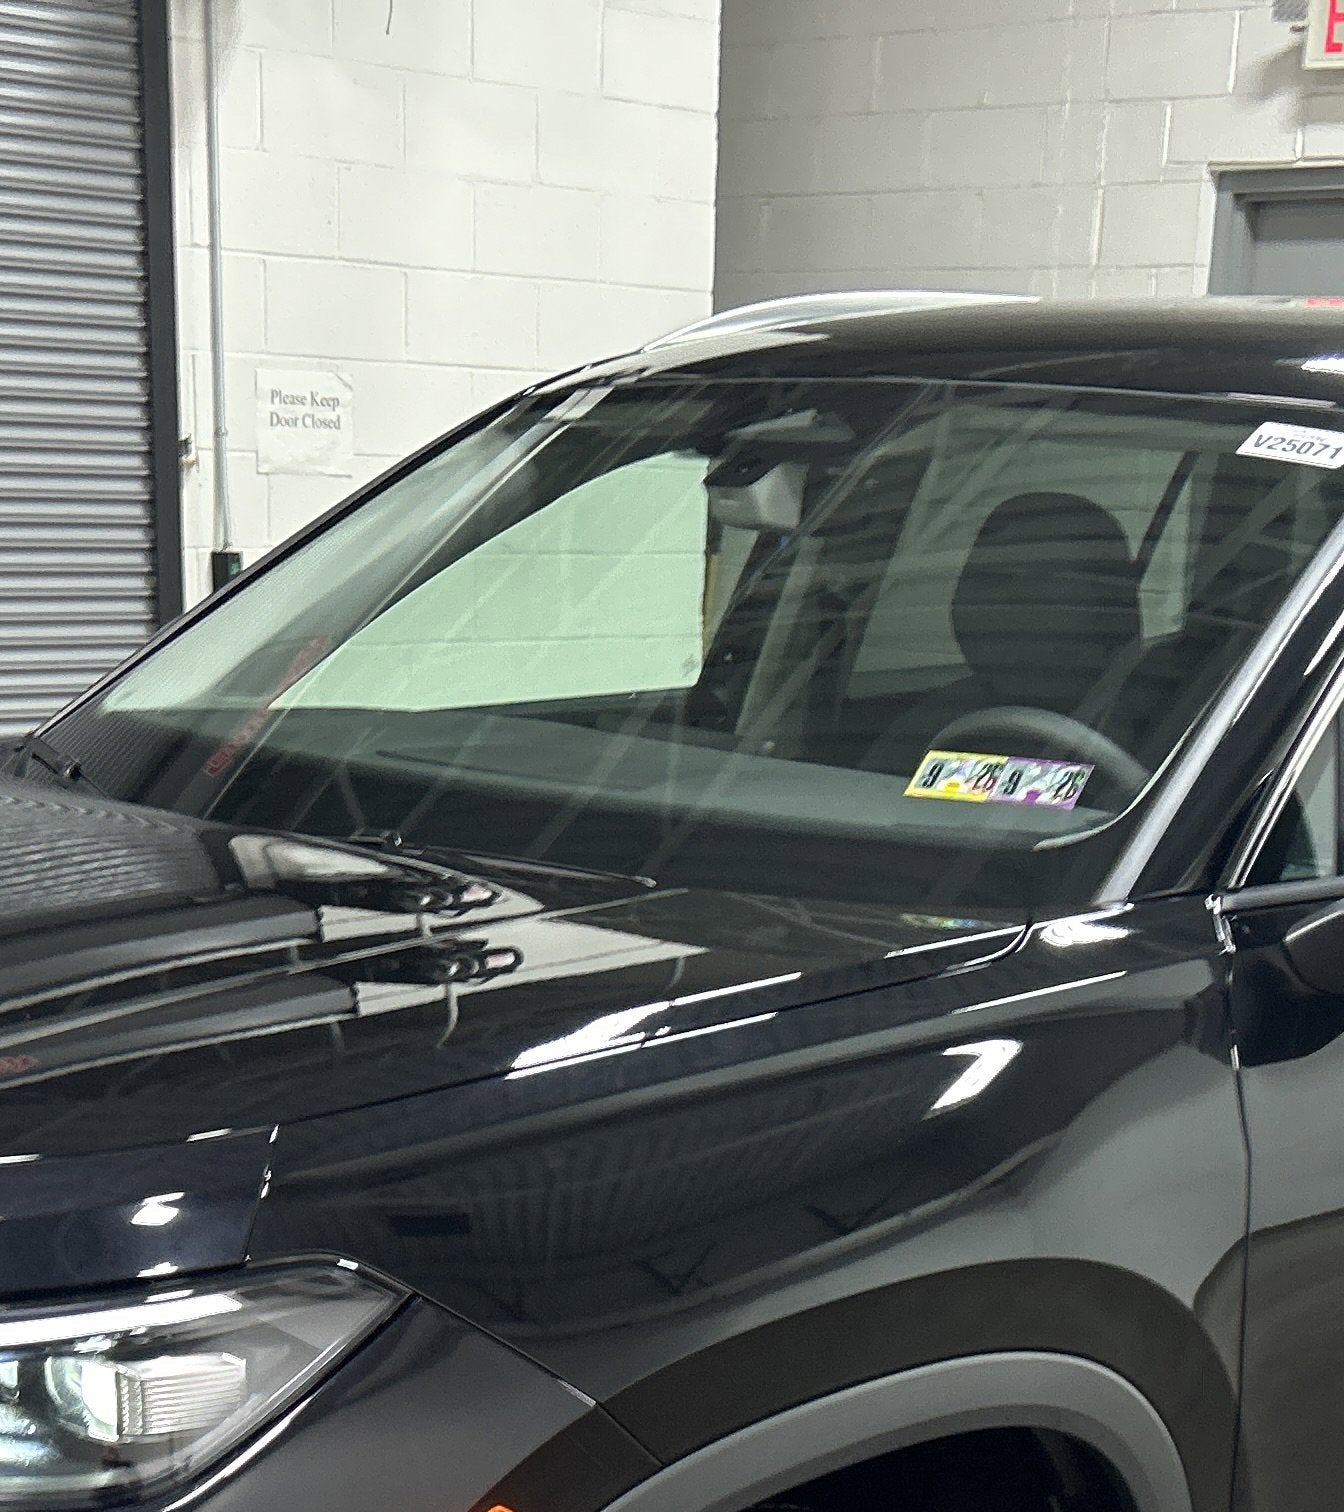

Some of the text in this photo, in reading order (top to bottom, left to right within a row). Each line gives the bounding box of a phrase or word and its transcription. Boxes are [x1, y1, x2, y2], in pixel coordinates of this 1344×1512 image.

[270, 388, 340, 412] Please Keep
[269, 411, 341, 430] Door Closed
[1253, 434, 1343, 460] V25071
